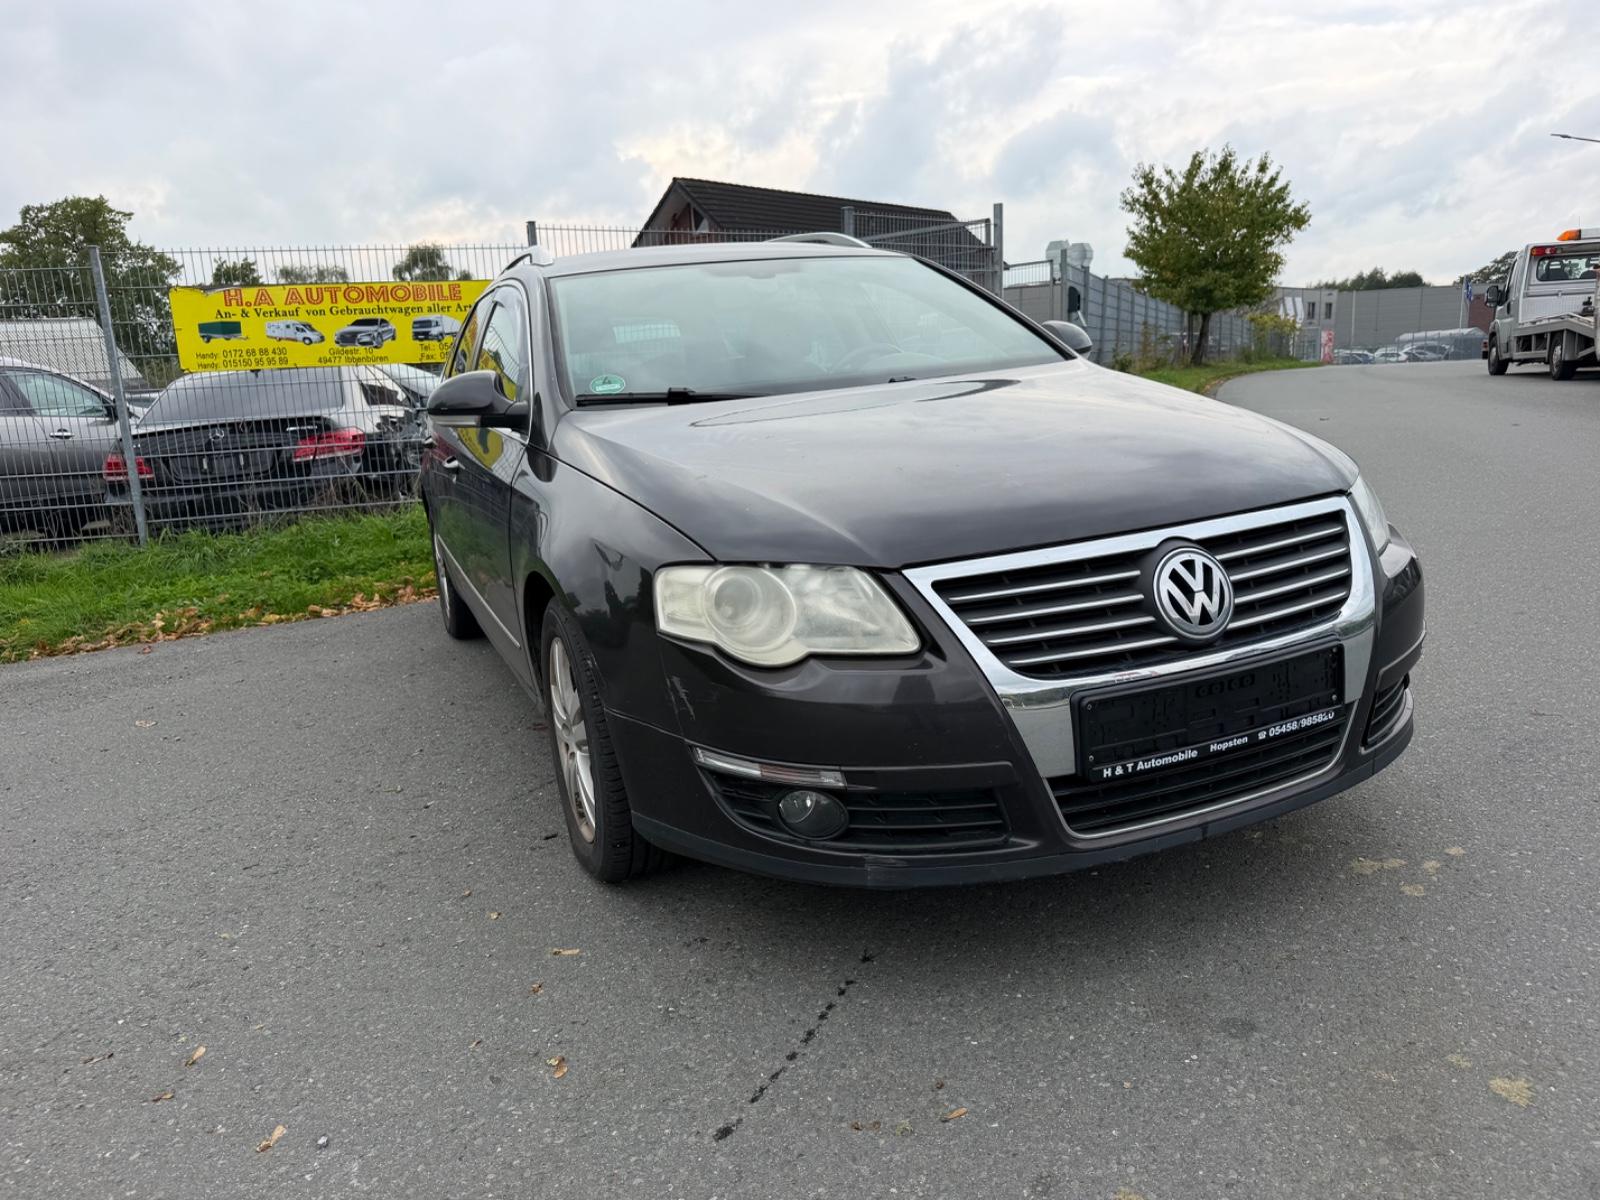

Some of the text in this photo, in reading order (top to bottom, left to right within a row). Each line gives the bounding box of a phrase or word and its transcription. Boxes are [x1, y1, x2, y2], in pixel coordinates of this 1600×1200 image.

[223, 283, 462, 307] H.A AUTOMOBILE
[215, 308, 237, 319] An-
[240, 307, 250, 318] &
[253, 306, 301, 318] Verkauf
[305, 307, 326, 316] von
[329, 304, 424, 317] Gebrauchtwagen
[427, 303, 452, 313] aller
[222, 349, 244, 358] 0172
[271, 346, 288, 356] 430
[222, 358, 253, 368] 015150
[318, 355, 389, 364] 49477 Ibbenbüren
[1103, 767, 1112, 778] H
[1114, 765, 1124, 776] &
[1126, 763, 1134, 773] T
[1136, 749, 1198, 771] Automobile
[1209, 736, 1248, 752] Hopsten
